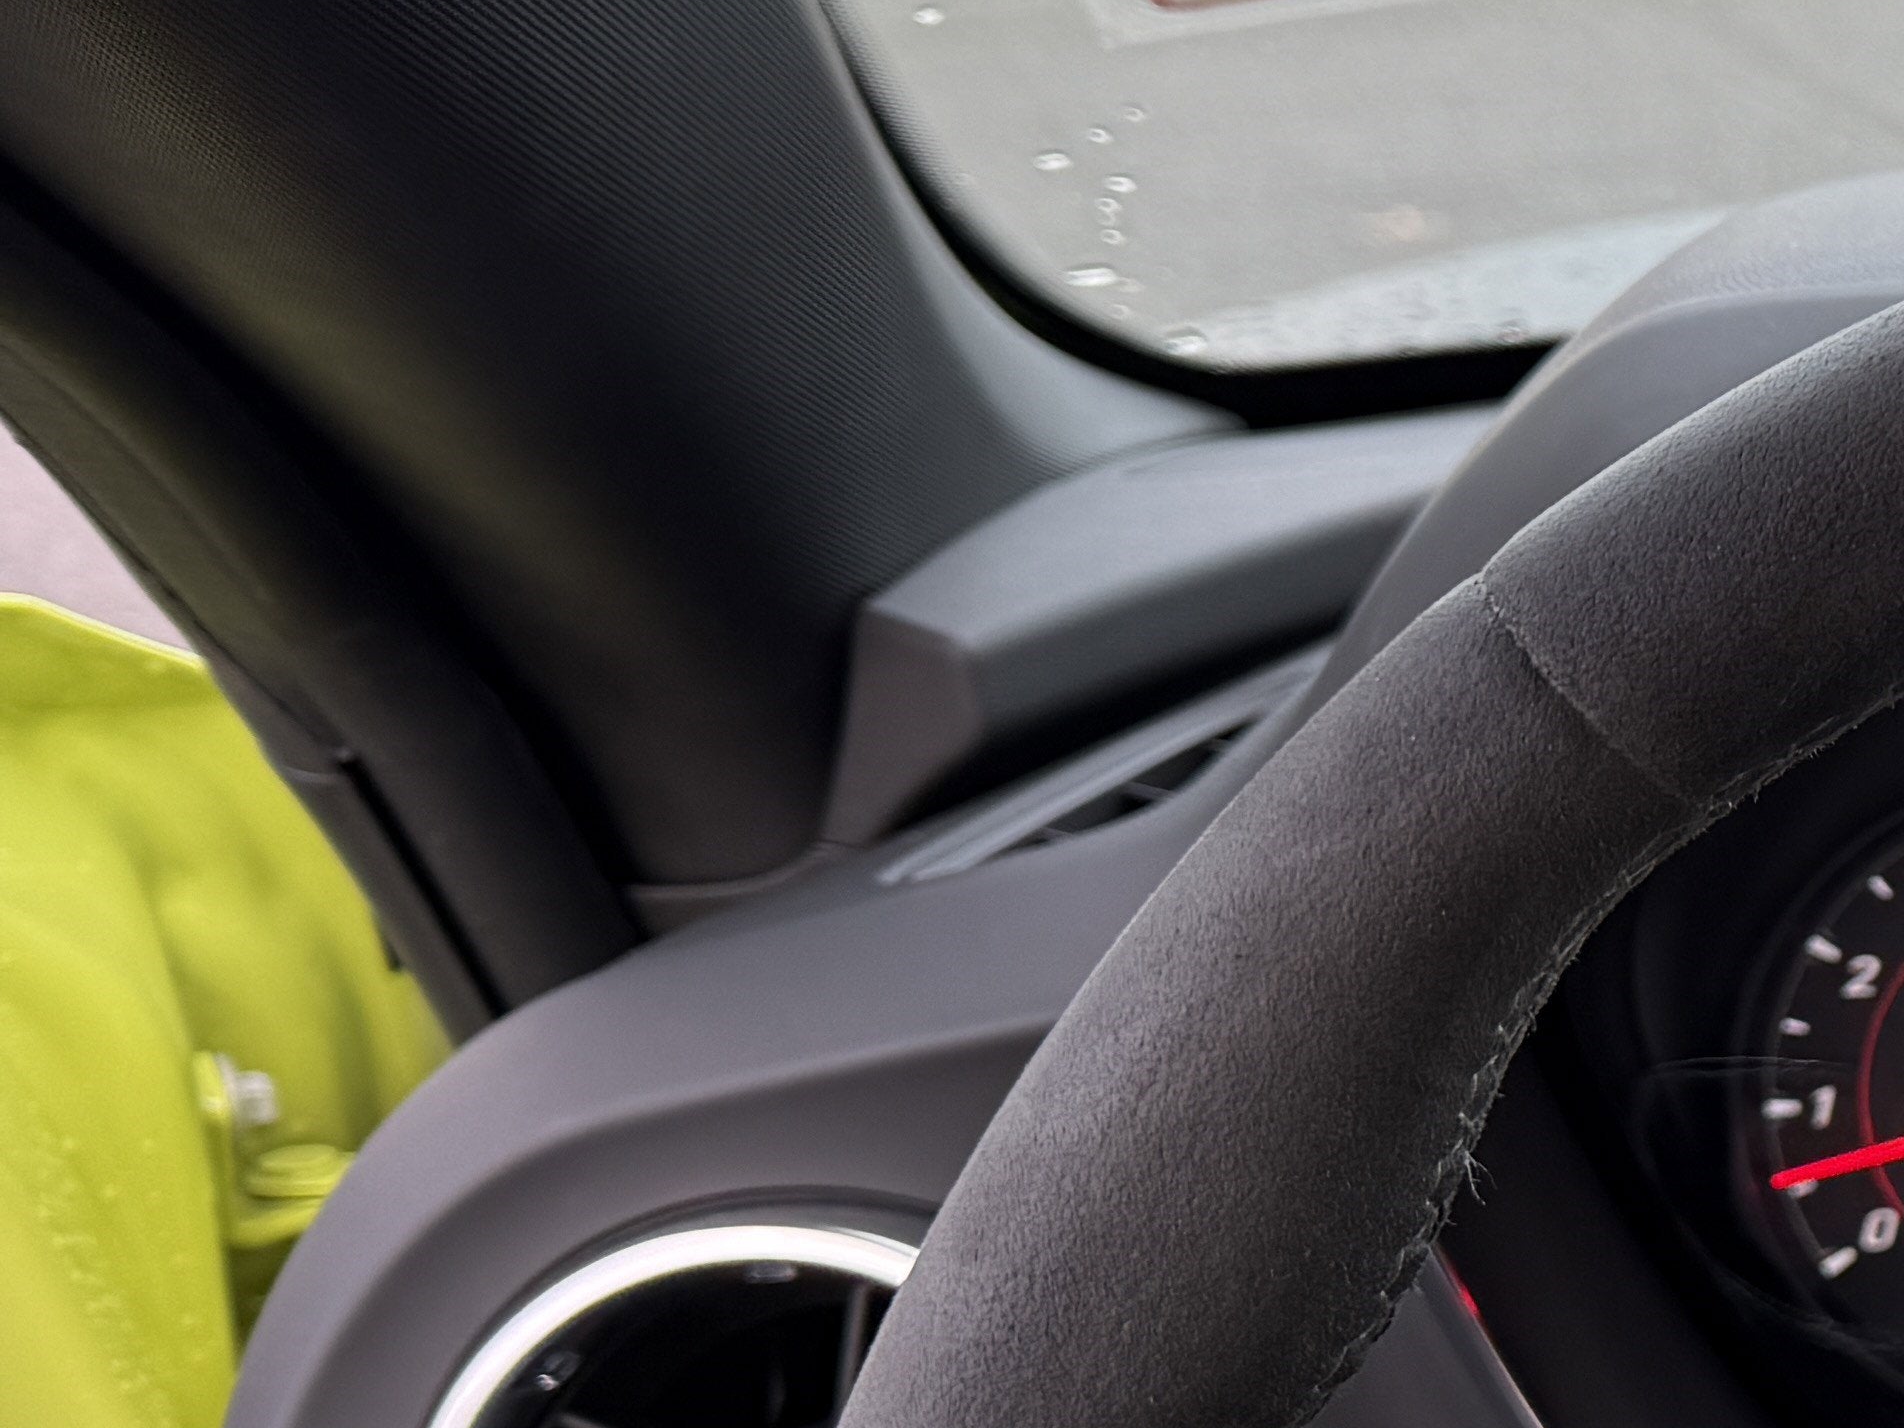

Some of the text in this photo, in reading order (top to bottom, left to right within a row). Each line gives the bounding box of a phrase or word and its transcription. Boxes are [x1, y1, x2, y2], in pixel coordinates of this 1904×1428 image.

[1842, 955, 1881, 1000] 2
[1811, 1085, 1836, 1129] 1
[1859, 1207, 1898, 1253] 0
